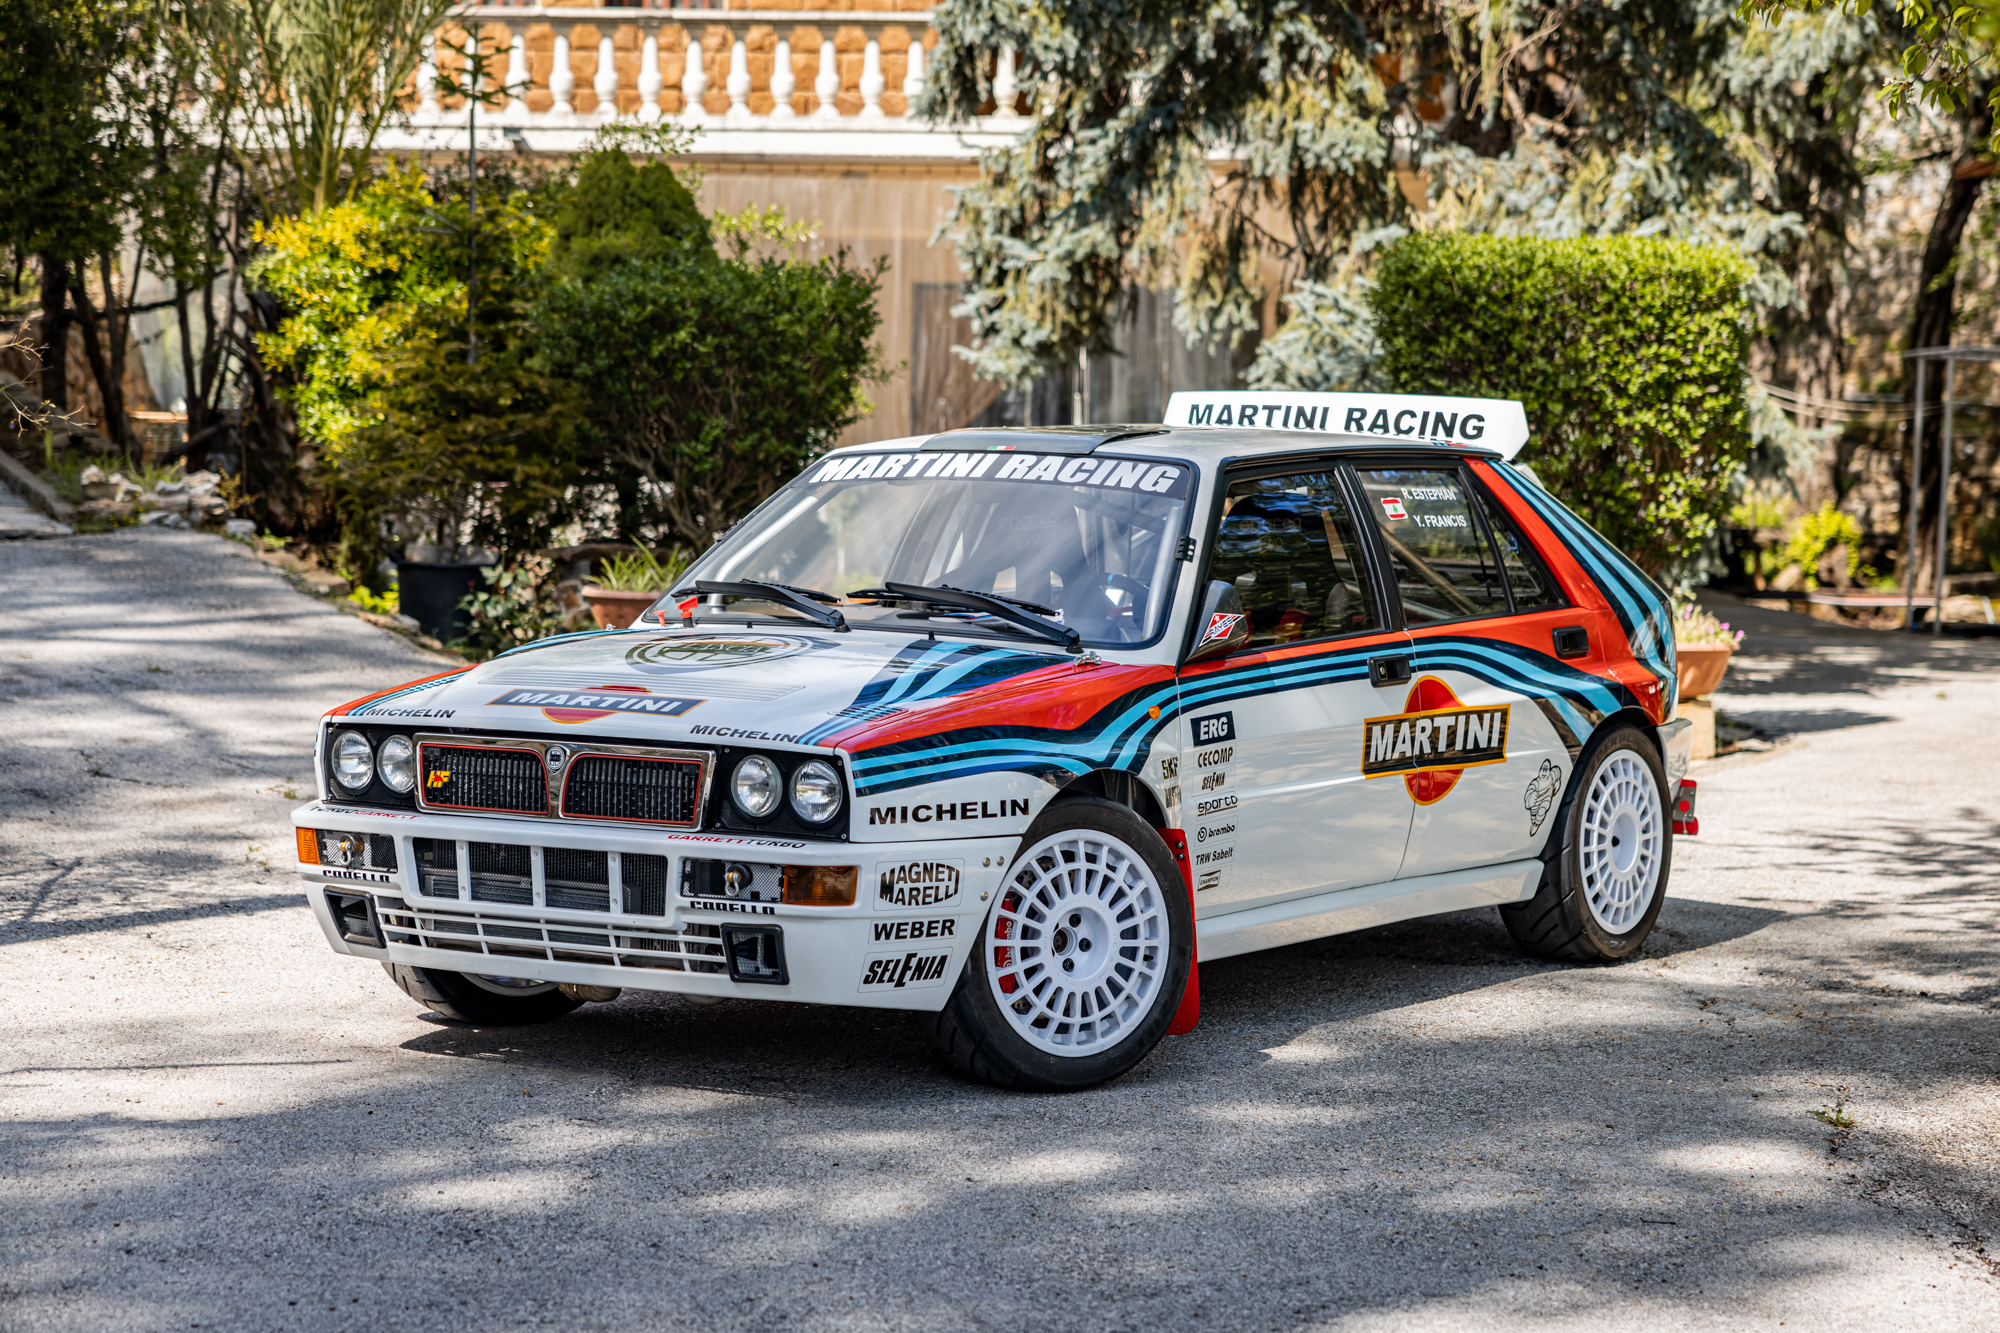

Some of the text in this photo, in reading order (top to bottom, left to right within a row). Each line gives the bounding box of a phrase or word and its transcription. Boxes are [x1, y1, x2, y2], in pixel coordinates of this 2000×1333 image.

[1188, 403, 1486, 440] MARTINI RACING
[809, 453, 1181, 494] MARTINI RACING
[1401, 487, 1457, 501] R. ESTEPHAN
[1413, 515, 1468, 528] Y. FRANCIS
[365, 708, 456, 719] MICHELIN
[507, 692, 684, 714] MARTINI
[689, 724, 801, 744] MICHELIN
[1200, 716, 1228, 741] ERG
[1369, 711, 1502, 763] MARTINI
[1197, 746, 1233, 768] CECOMP
[427, 770, 450, 788] HF
[1201, 771, 1225, 791] SELENIA
[869, 798, 1030, 825] MICHELIN
[1197, 795, 1238, 816] sparco
[1208, 823, 1235, 838] brembo
[1195, 846, 1234, 866] TRW Sabelt
[880, 861, 960, 887] MAGNETI
[880, 885, 960, 907] MARELLI
[874, 918, 956, 941] WEBER
[1004, 920, 1013, 958] brmbo
[863, 952, 949, 988] SELENIA
